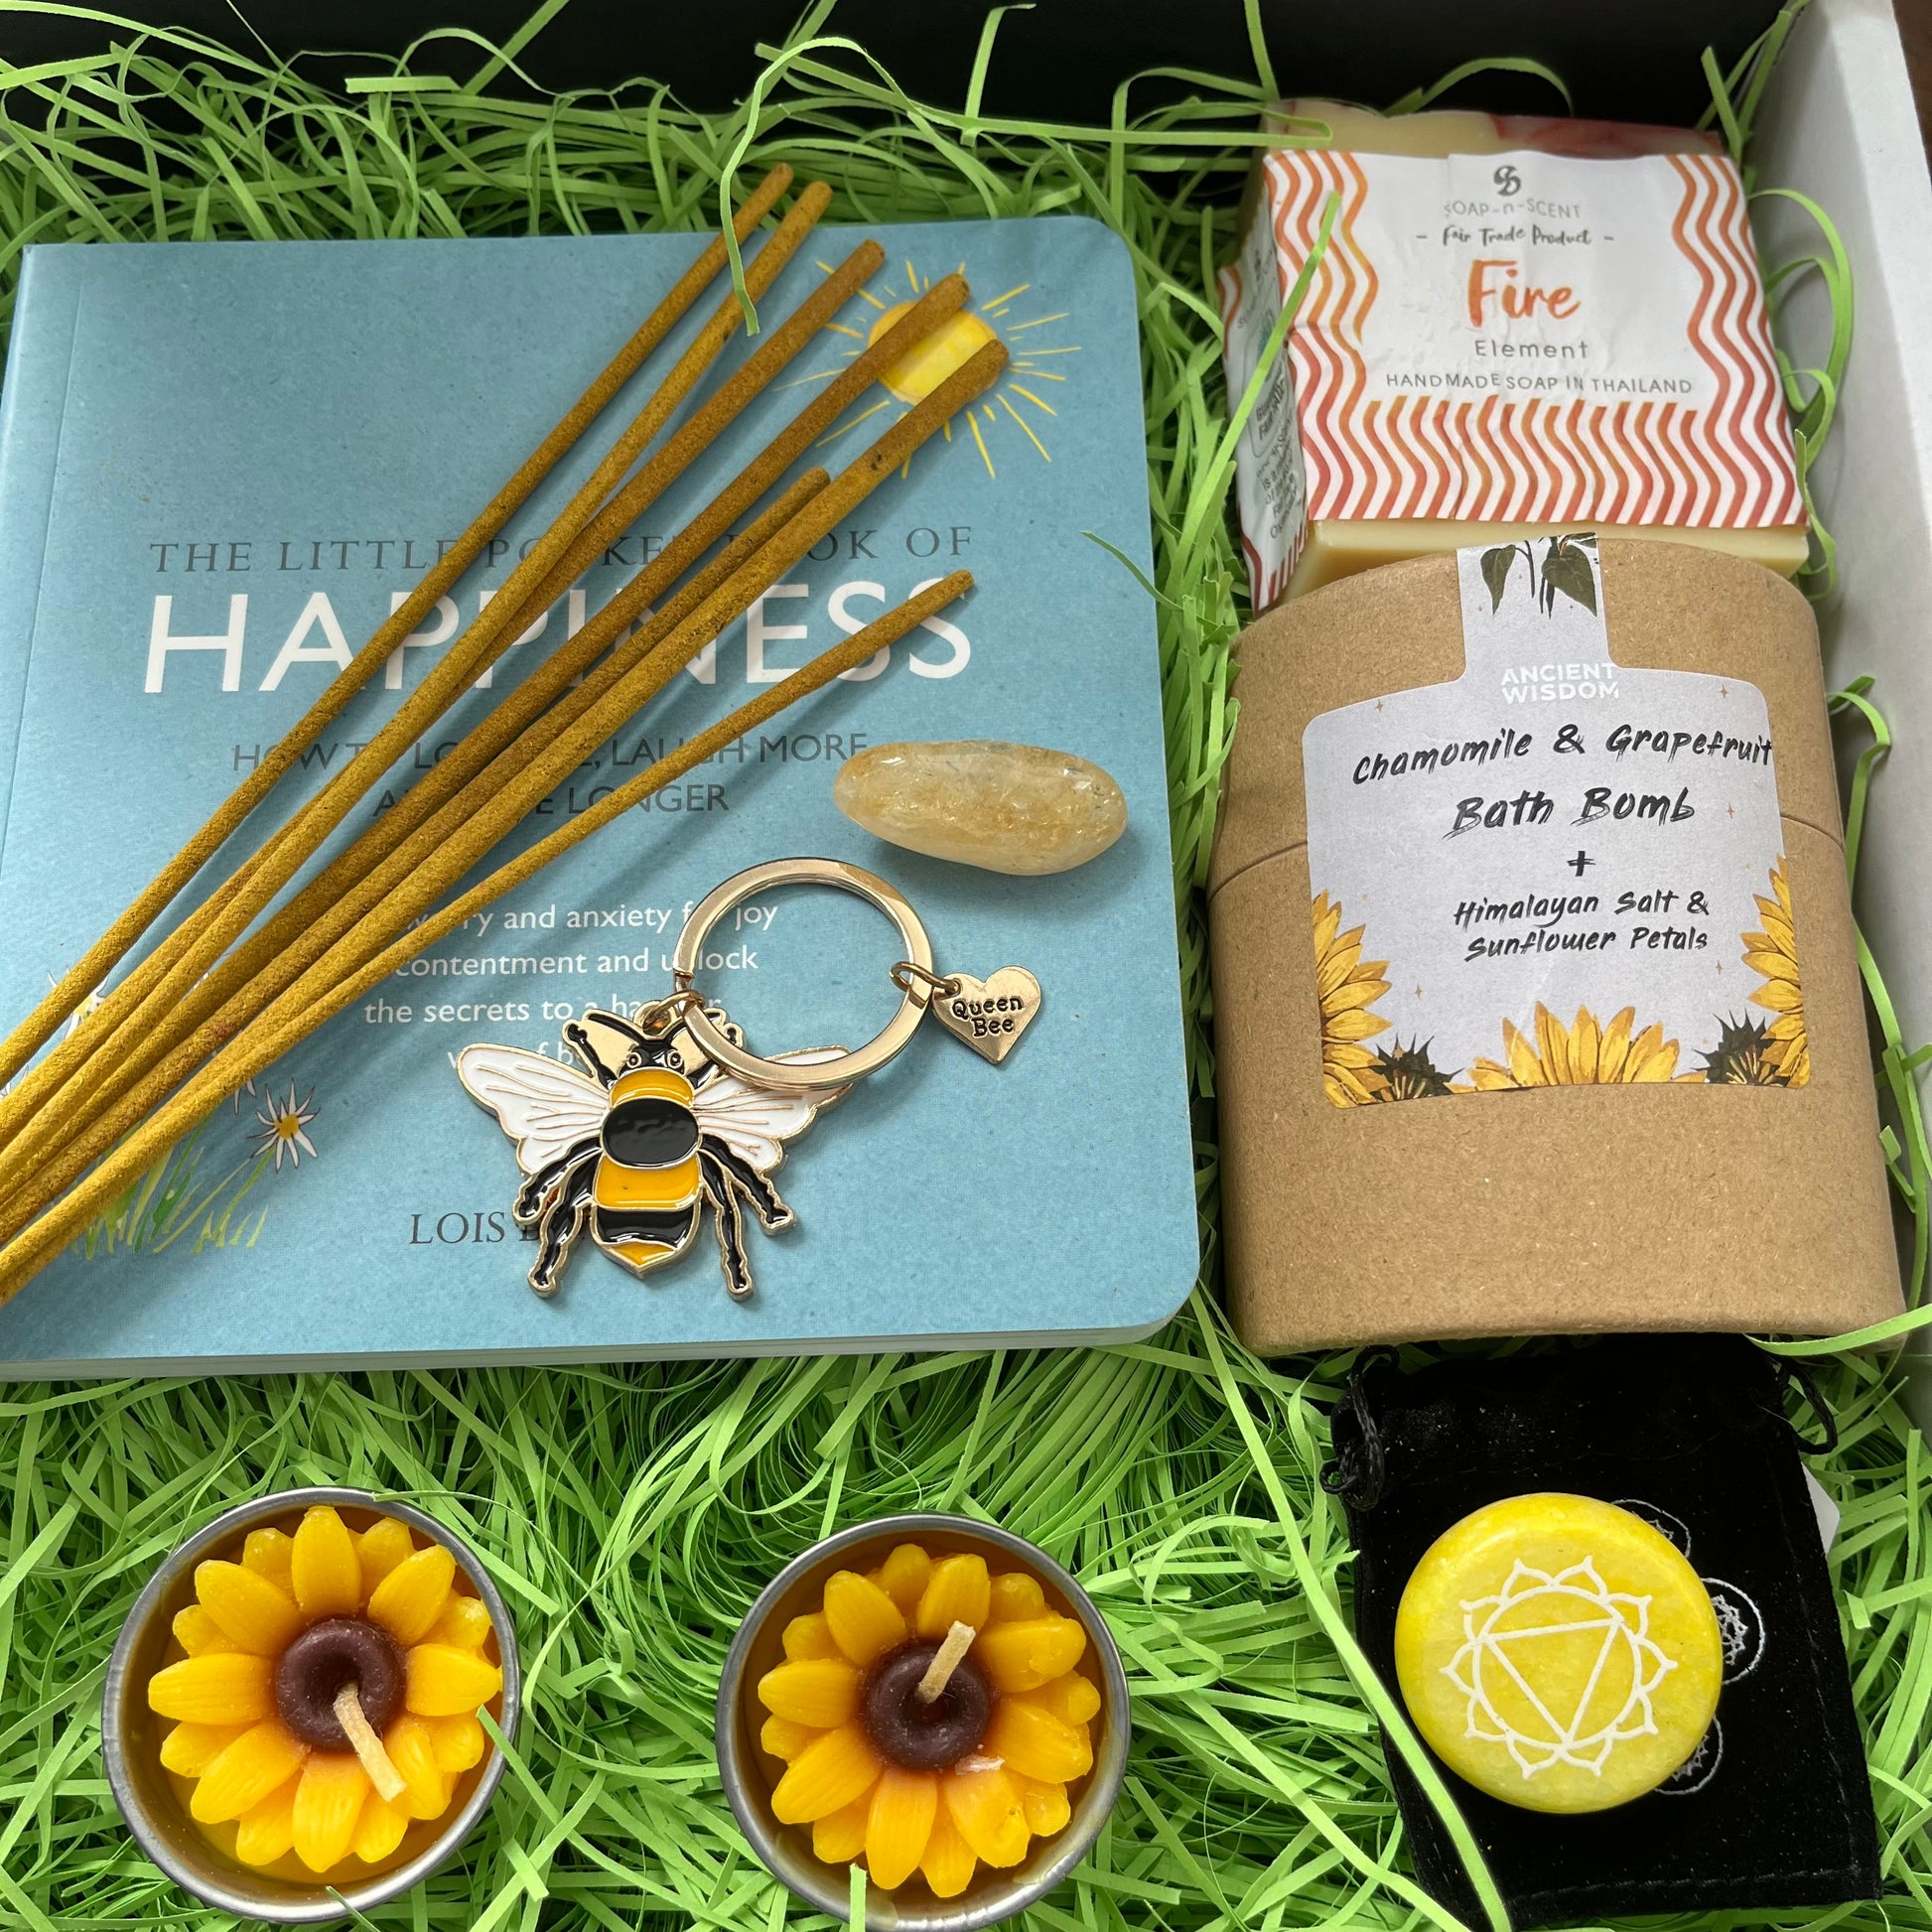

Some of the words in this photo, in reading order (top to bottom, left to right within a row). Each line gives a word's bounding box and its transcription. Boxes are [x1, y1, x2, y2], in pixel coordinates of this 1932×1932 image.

[1443, 224, 1471, 246] Fair
[1479, 225, 1526, 246] Trade
[1532, 223, 1591, 246] Product
[1467, 259, 1582, 328] Fire
[1475, 340, 1588, 358] Element
[1386, 373, 1500, 388] HANDMADE
[1506, 376, 1558, 390] SOAP
[1566, 376, 1585, 391] IN
[1592, 378, 1693, 394] THAILAND
[150, 542, 252, 572] THE
[905, 525, 973, 558] OF
[1500, 662, 1617, 686] ANCIENT
[1501, 681, 1620, 705] WISDOM
[233, 742, 339, 771] HW
[759, 733, 868, 762] MORE
[1353, 728, 1534, 785] Chamomile
[1553, 724, 1587, 755] &
[1605, 724, 1773, 766] Grapefruit
[1442, 789, 1555, 841] Bath
[1570, 786, 1696, 827] Bomb
[1567, 850, 1596, 878] +
[504, 904, 556, 930] and
[567, 903, 672, 934] anxiety
[735, 904, 778, 931] joy
[1453, 894, 1599, 929] Himalayan
[1614, 888, 1681, 916] Salt
[1687, 890, 1711, 916] &
[1463, 924, 1617, 963] Sunflower
[1629, 925, 1709, 951] Petals
[395, 953, 588, 977] contentment
[597, 946, 650, 973] and
[661, 944, 759, 971] ulock
[364, 998, 413, 1024] the
[424, 1002, 531, 1023] secrets
[541, 1000, 574, 1021] to
[952, 996, 1024, 1021] Queen
[971, 1018, 1014, 1037] Bee
[409, 1211, 506, 1245] LOIS
